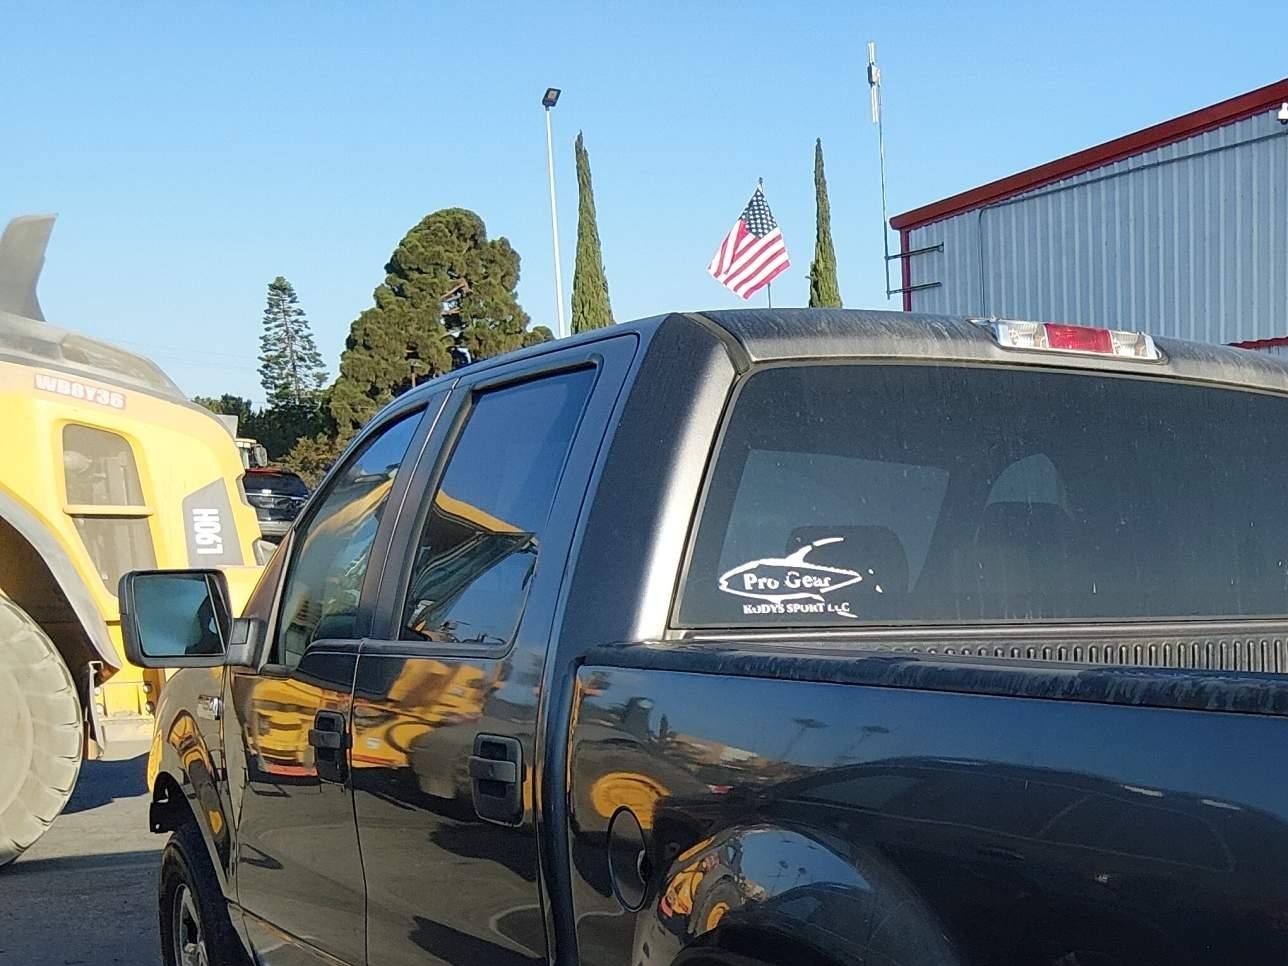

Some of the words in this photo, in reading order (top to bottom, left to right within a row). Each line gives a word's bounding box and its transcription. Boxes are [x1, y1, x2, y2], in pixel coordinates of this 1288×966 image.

[192, 507, 224, 556] L90H
[743, 573, 780, 591] Pro
[785, 571, 832, 588] Gear
